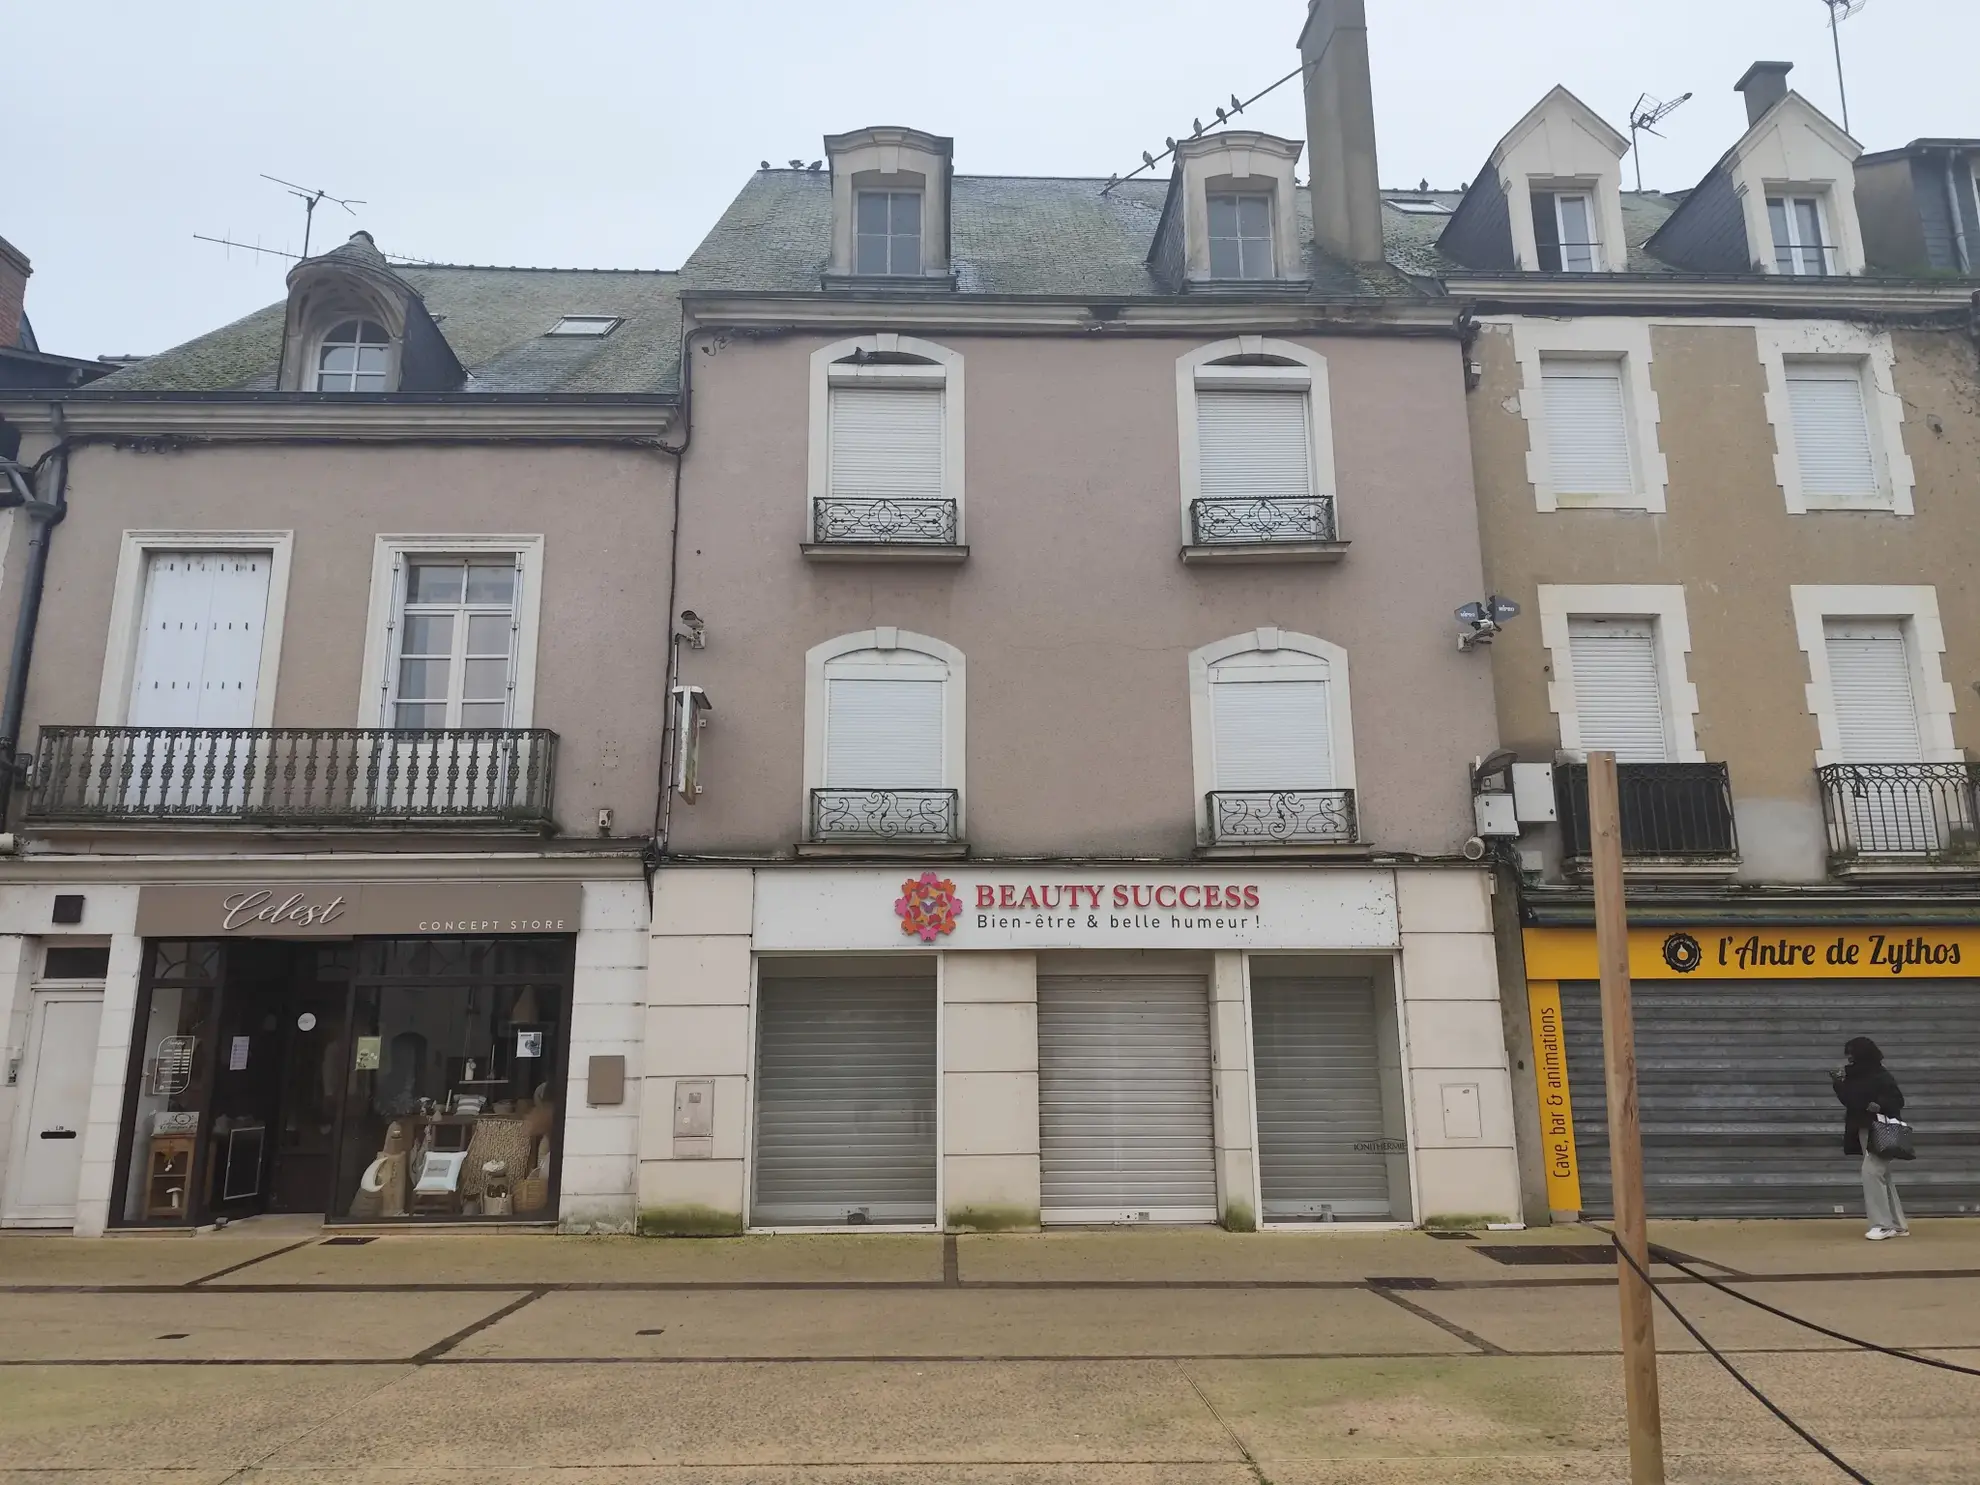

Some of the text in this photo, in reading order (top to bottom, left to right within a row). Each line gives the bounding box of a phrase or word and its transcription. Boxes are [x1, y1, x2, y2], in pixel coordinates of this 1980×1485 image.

[222, 889, 346, 931] Celest
[975, 884, 1260, 910] BEAUTY SUCCESS
[419, 919, 565, 931] CONCEPT STORE
[977, 914, 1076, 929] Bien-être
[1087, 914, 1099, 929] &
[1110, 914, 1161, 929] belle
[1718, 935, 1962, 975] l'Antre de Zythos
[1540, 1007, 1571, 1178] Cave, bar & animations
